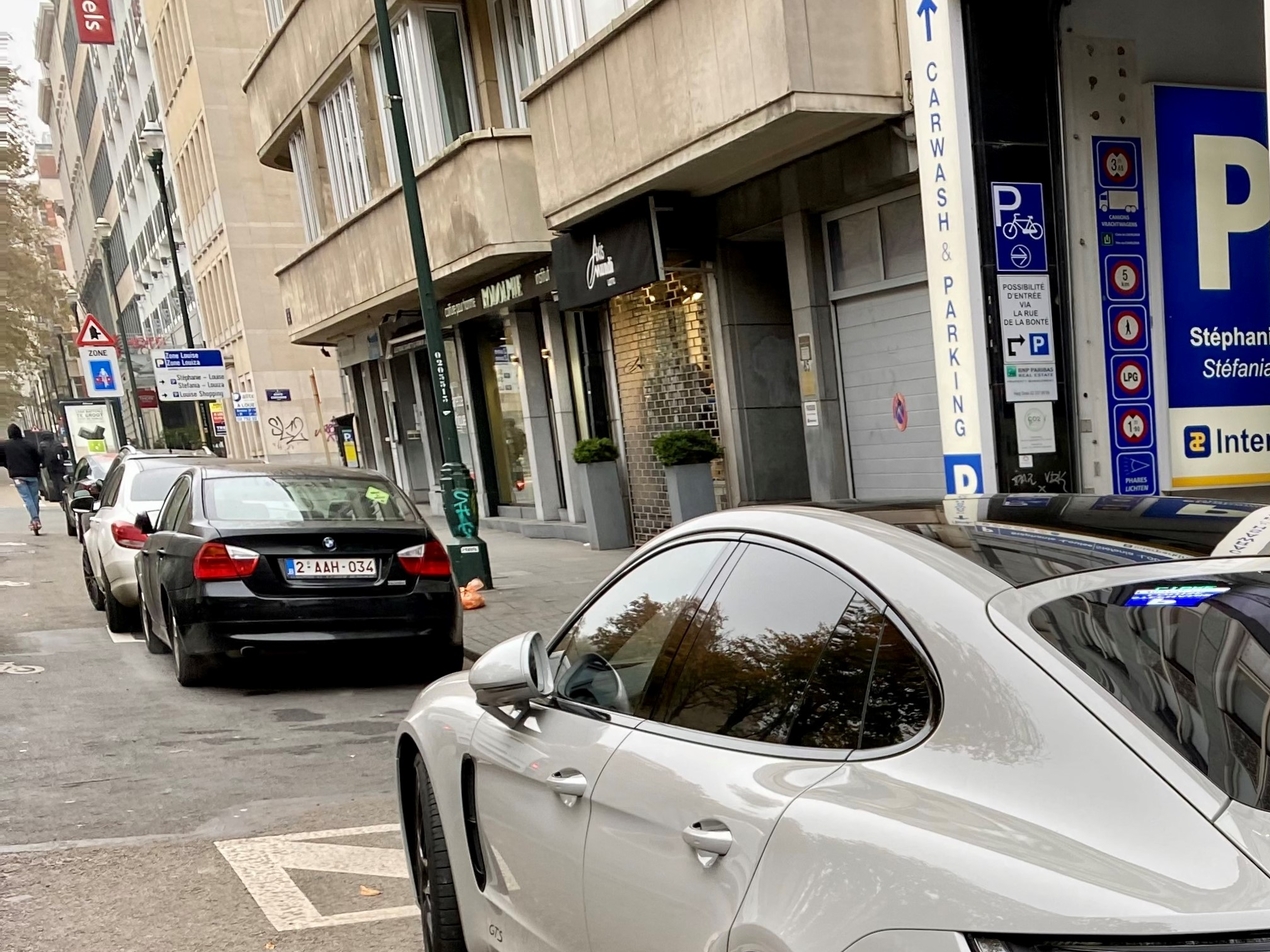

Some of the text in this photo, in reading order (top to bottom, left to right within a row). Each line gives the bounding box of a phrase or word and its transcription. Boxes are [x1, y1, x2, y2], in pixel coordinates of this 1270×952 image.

[993, 185, 1022, 227] P
[1193, 134, 1270, 290] P
[926, 61, 966, 437] CARWASH & PARKING
[1122, 269, 1128, 281] 5
[1003, 283, 1045, 291] POSSIBILITÉ
[1007, 291, 1042, 300] D'ENTRÉE
[1026, 316, 1049, 325] BONTÉ
[1032, 336, 1045, 353] P
[1123, 372, 1138, 382] LPG
[199, 390, 224, 398] Shopping
[1125, 476, 1148, 484] PHARES
[1125, 484, 1149, 492] LICHTEN
[488, 924, 503, 943] GTS
